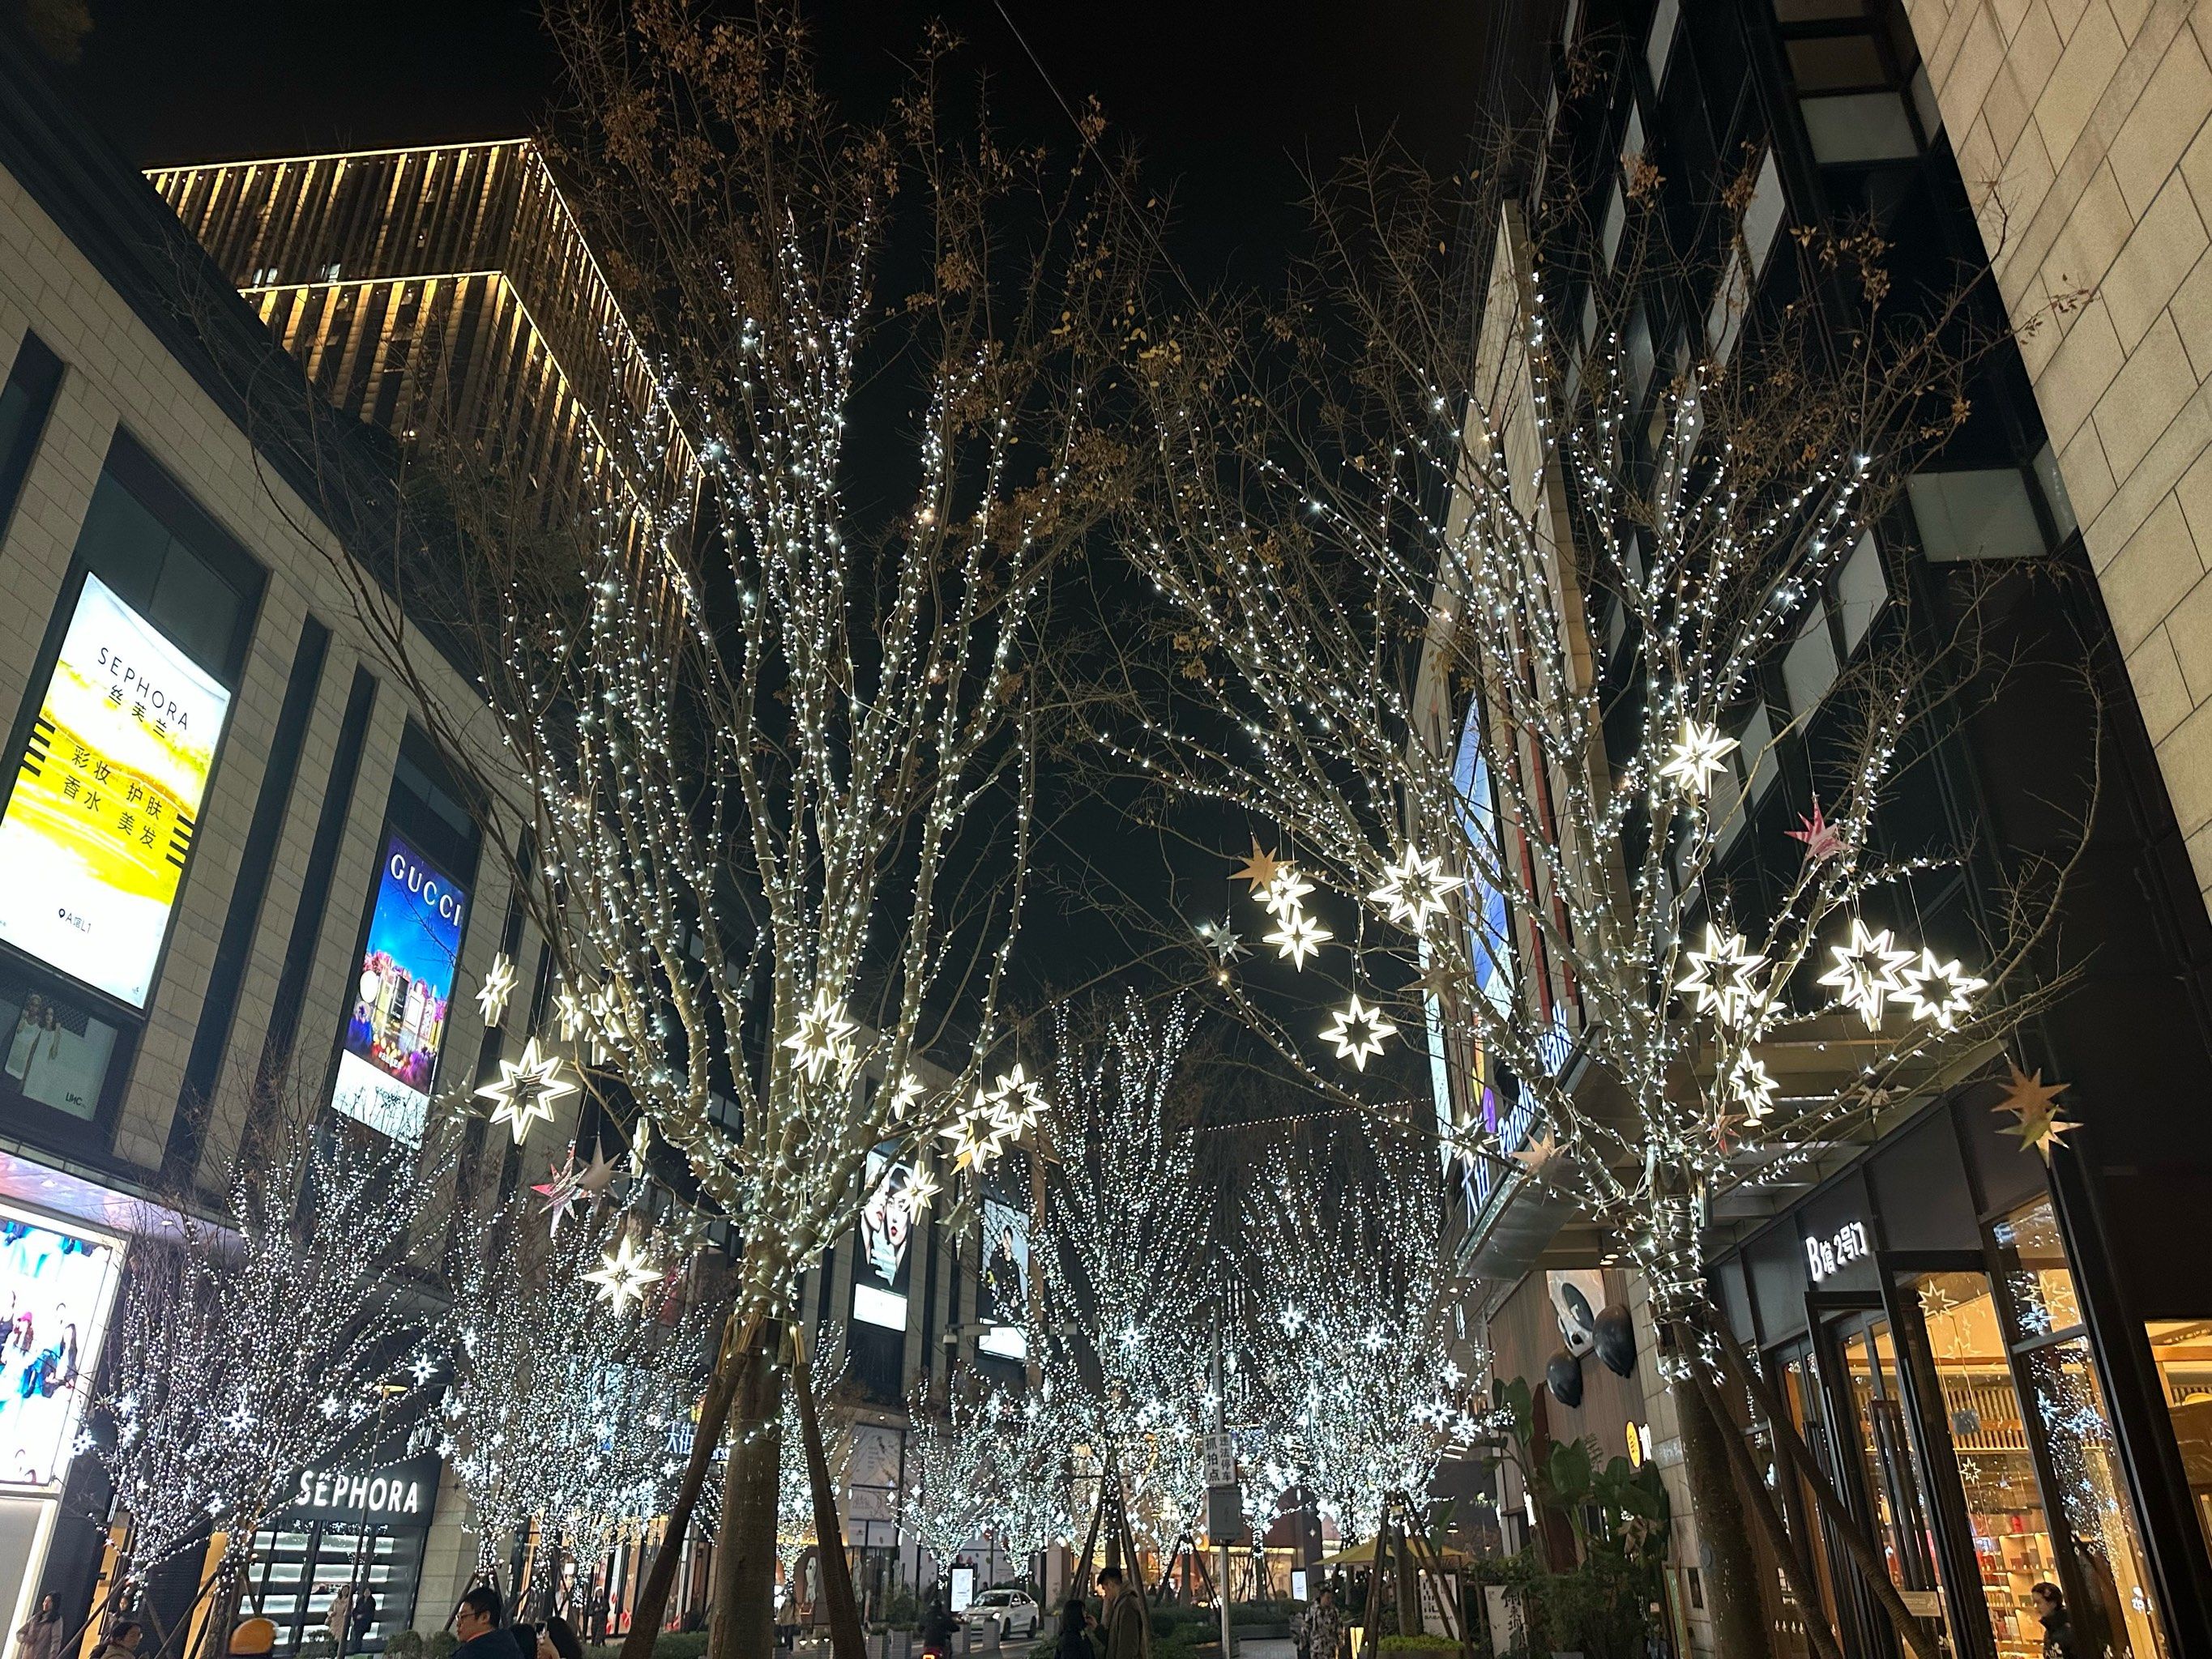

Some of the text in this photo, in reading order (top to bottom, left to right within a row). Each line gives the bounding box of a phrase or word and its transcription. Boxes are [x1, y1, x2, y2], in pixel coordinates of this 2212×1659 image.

[97, 647, 188, 731] SEPHORA
[109, 684, 167, 739] 丝芙兰
[64, 774, 156, 850] 香水 美发
[72, 745, 162, 820] 彩妆 护肤
[391, 854, 461, 927] GUCCI
[1205, 1437, 1220, 1482] 抓拍点
[1219, 1435, 1232, 1482] 违法停车
[295, 1469, 418, 1513] SEPHORA
